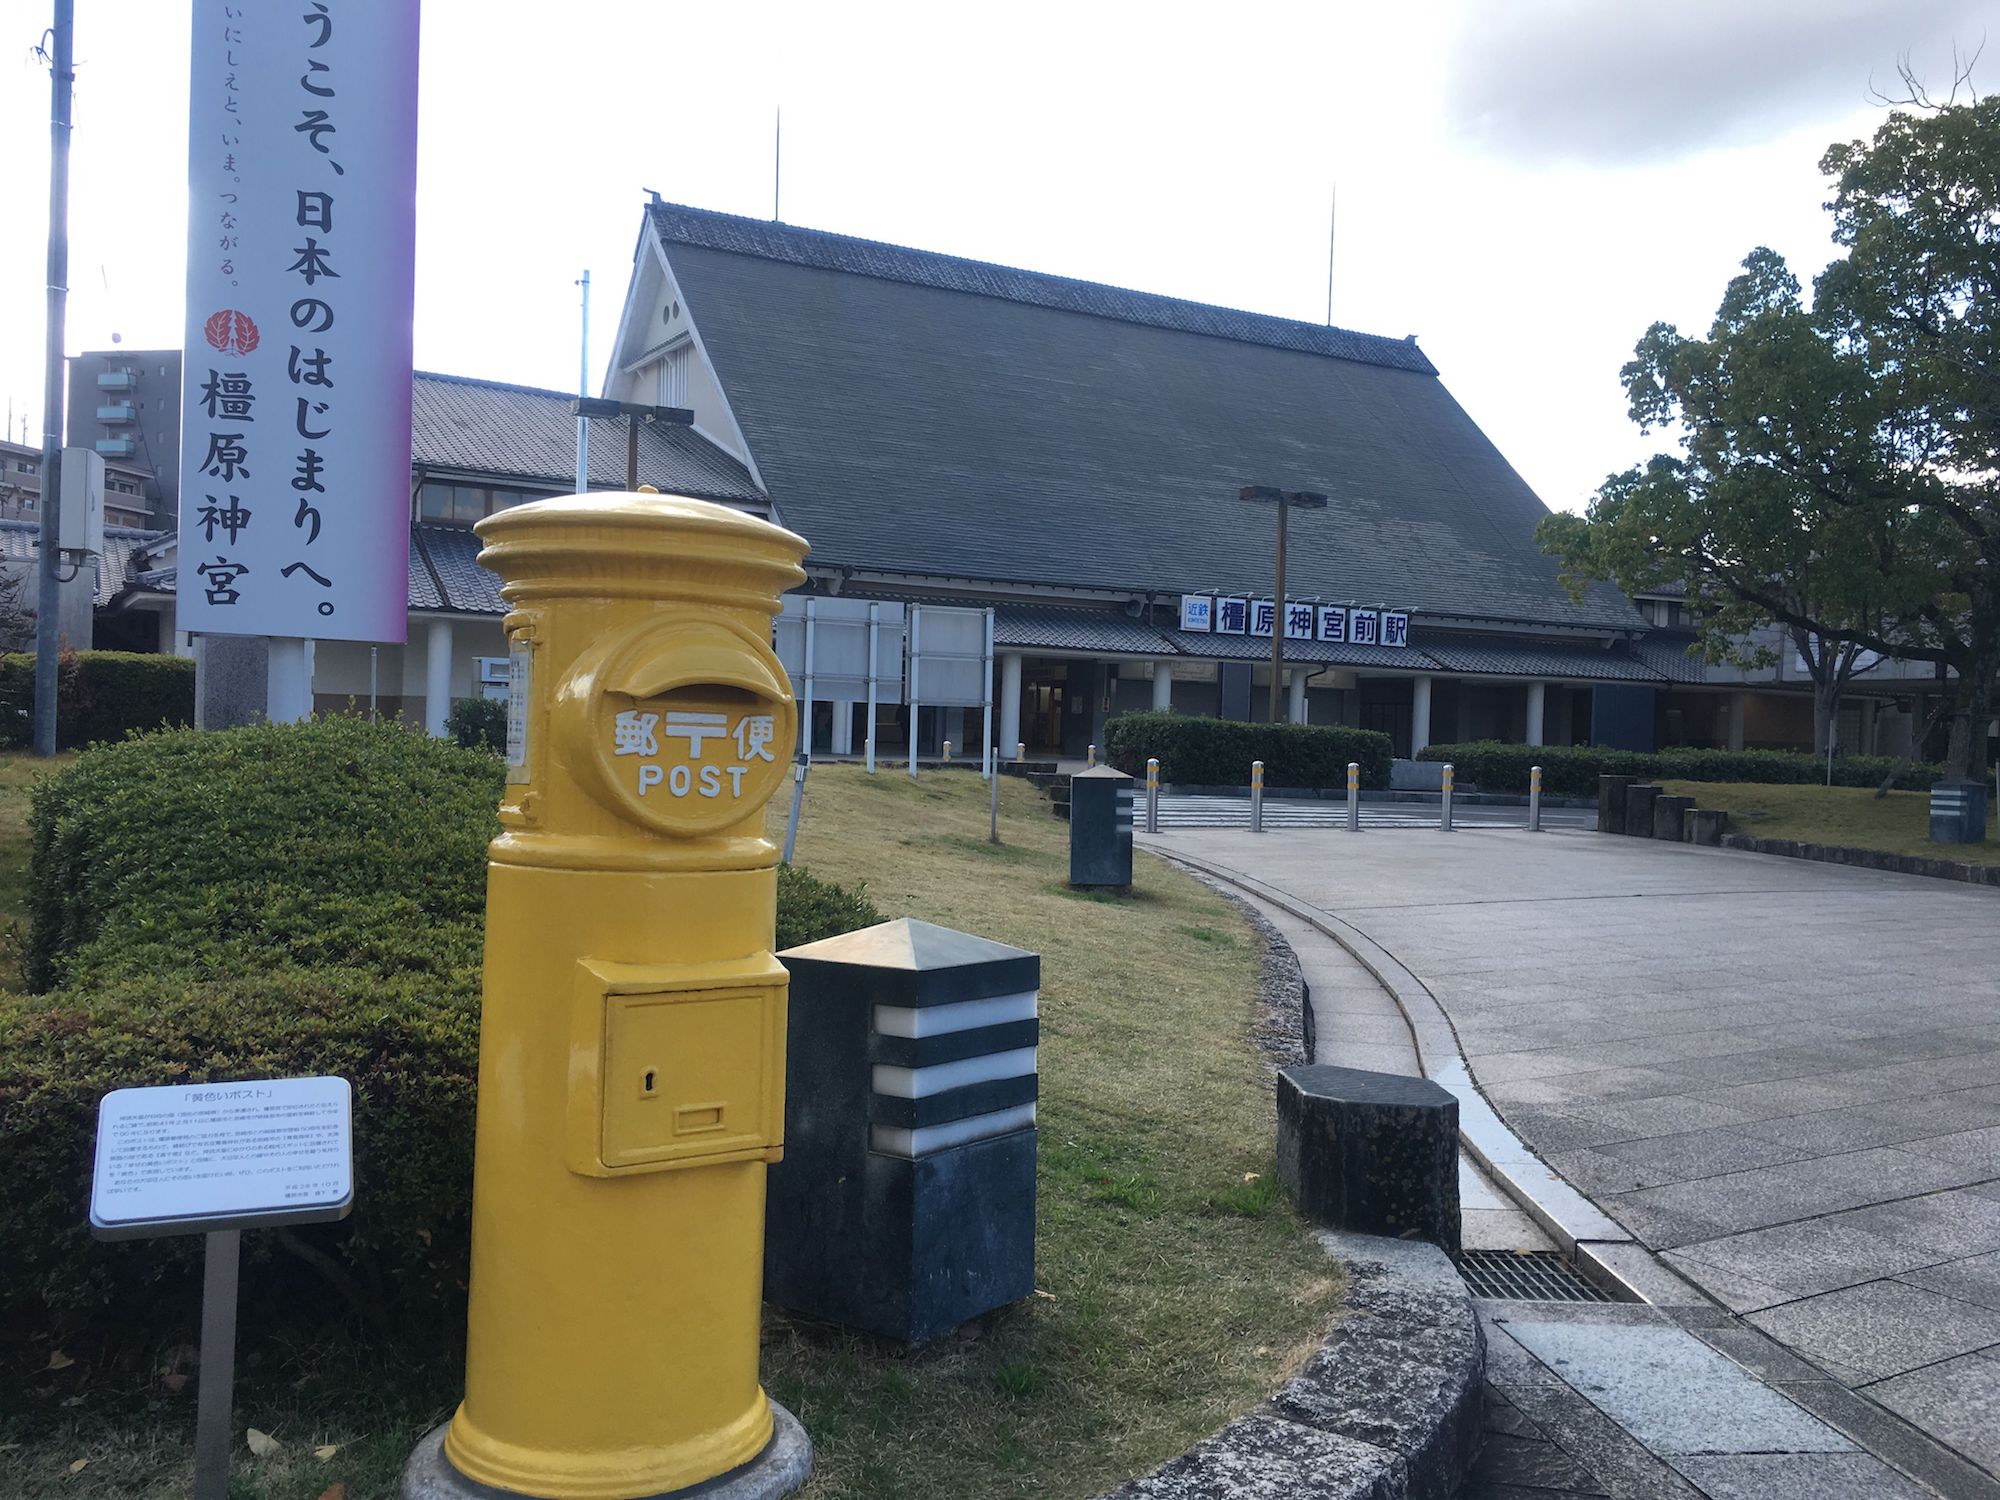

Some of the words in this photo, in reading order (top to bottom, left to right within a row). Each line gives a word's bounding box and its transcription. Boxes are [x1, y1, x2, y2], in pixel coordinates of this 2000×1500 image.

[219, 5, 243, 287] いにしえと、いま。つながる。
[281, 2, 344, 617] うこそ、日本のはじまりへ。
[195, 368, 257, 607] 橿原神宮
[1187, 602, 1209, 617] 近鉄
[1221, 600, 1407, 645] 橿原神宮前駅
[637, 764, 749, 798] POST
